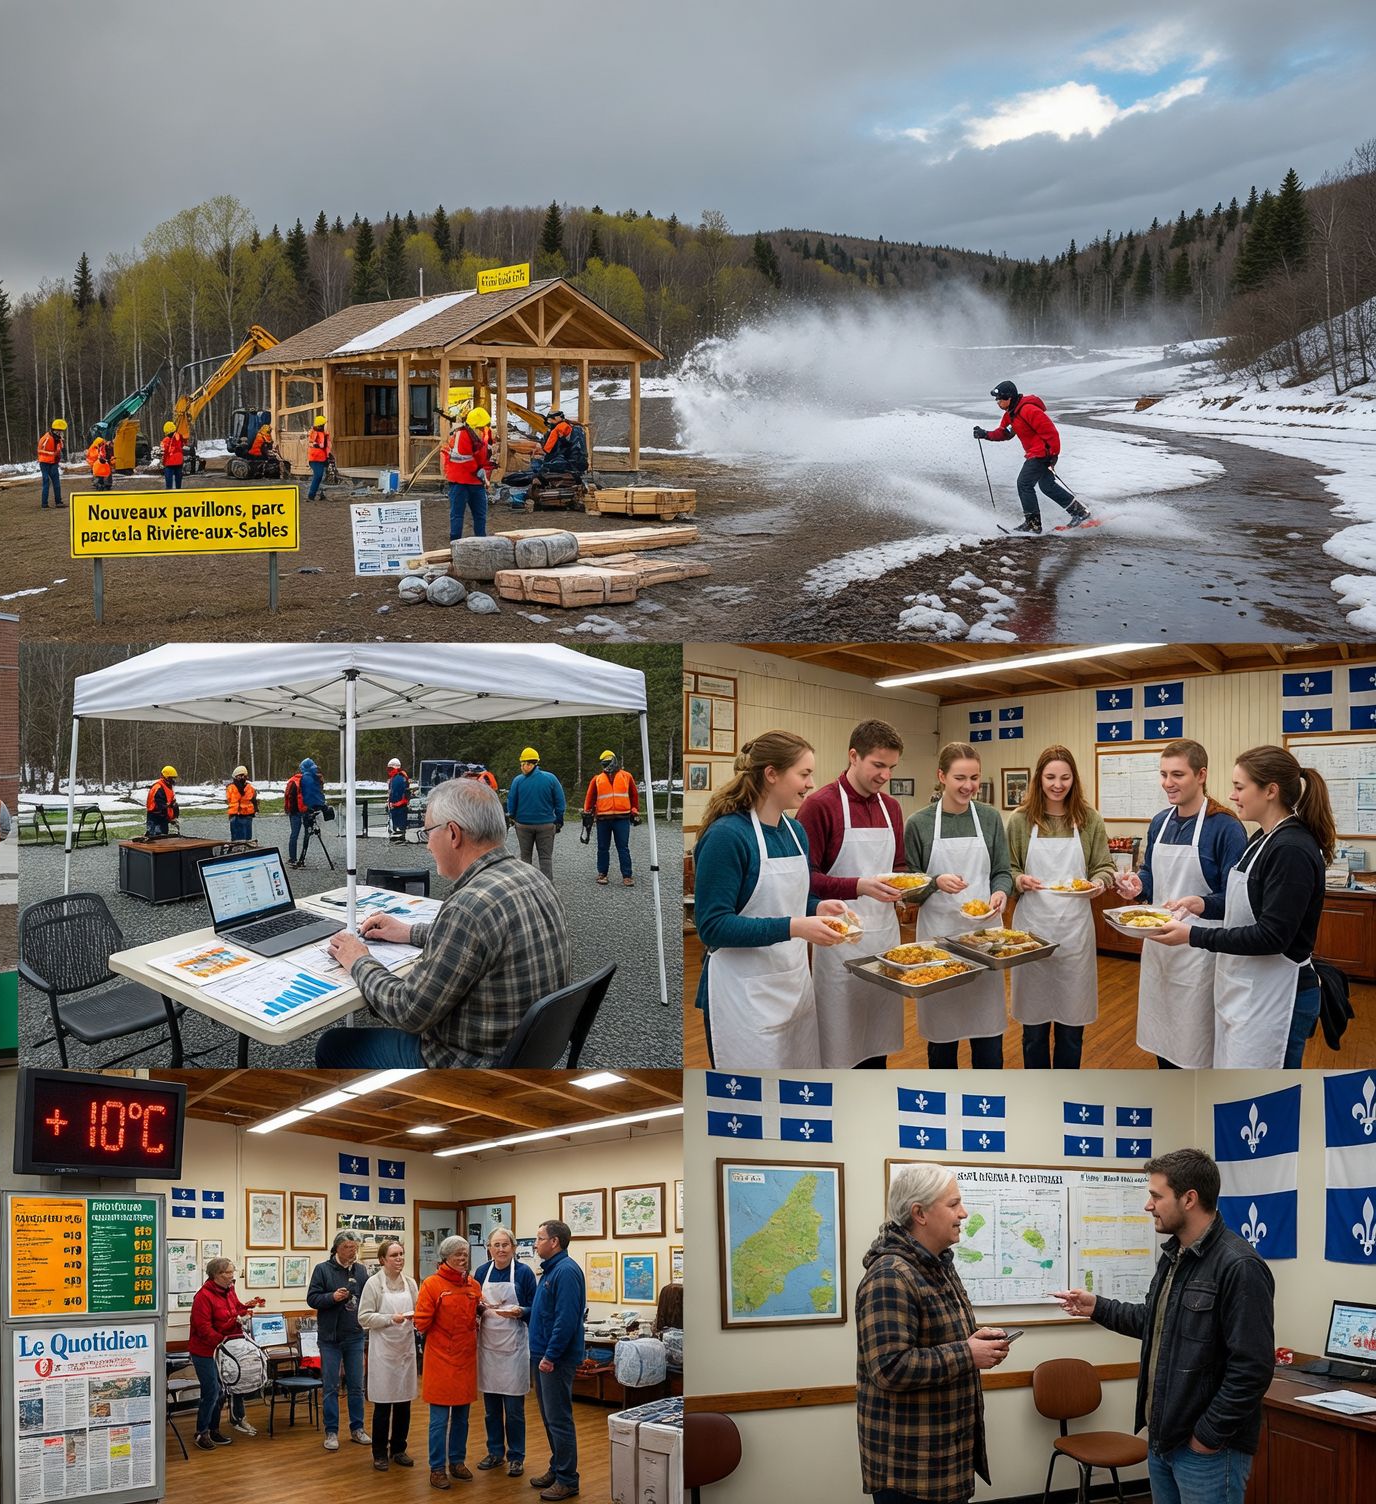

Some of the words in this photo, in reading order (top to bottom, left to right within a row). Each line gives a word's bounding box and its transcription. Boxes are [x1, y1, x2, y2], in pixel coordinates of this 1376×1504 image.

[88, 504, 167, 521] Nouveaux
[173, 501, 246, 522] pavillons,
[251, 503, 285, 519] parc
[128, 525, 142, 541] la
[147, 521, 288, 541] Rivière-aux-Sables
[89, 1100, 167, 1154] 10°C
[18, 1335, 45, 1357] Le
[50, 1330, 150, 1360] Quotidien
